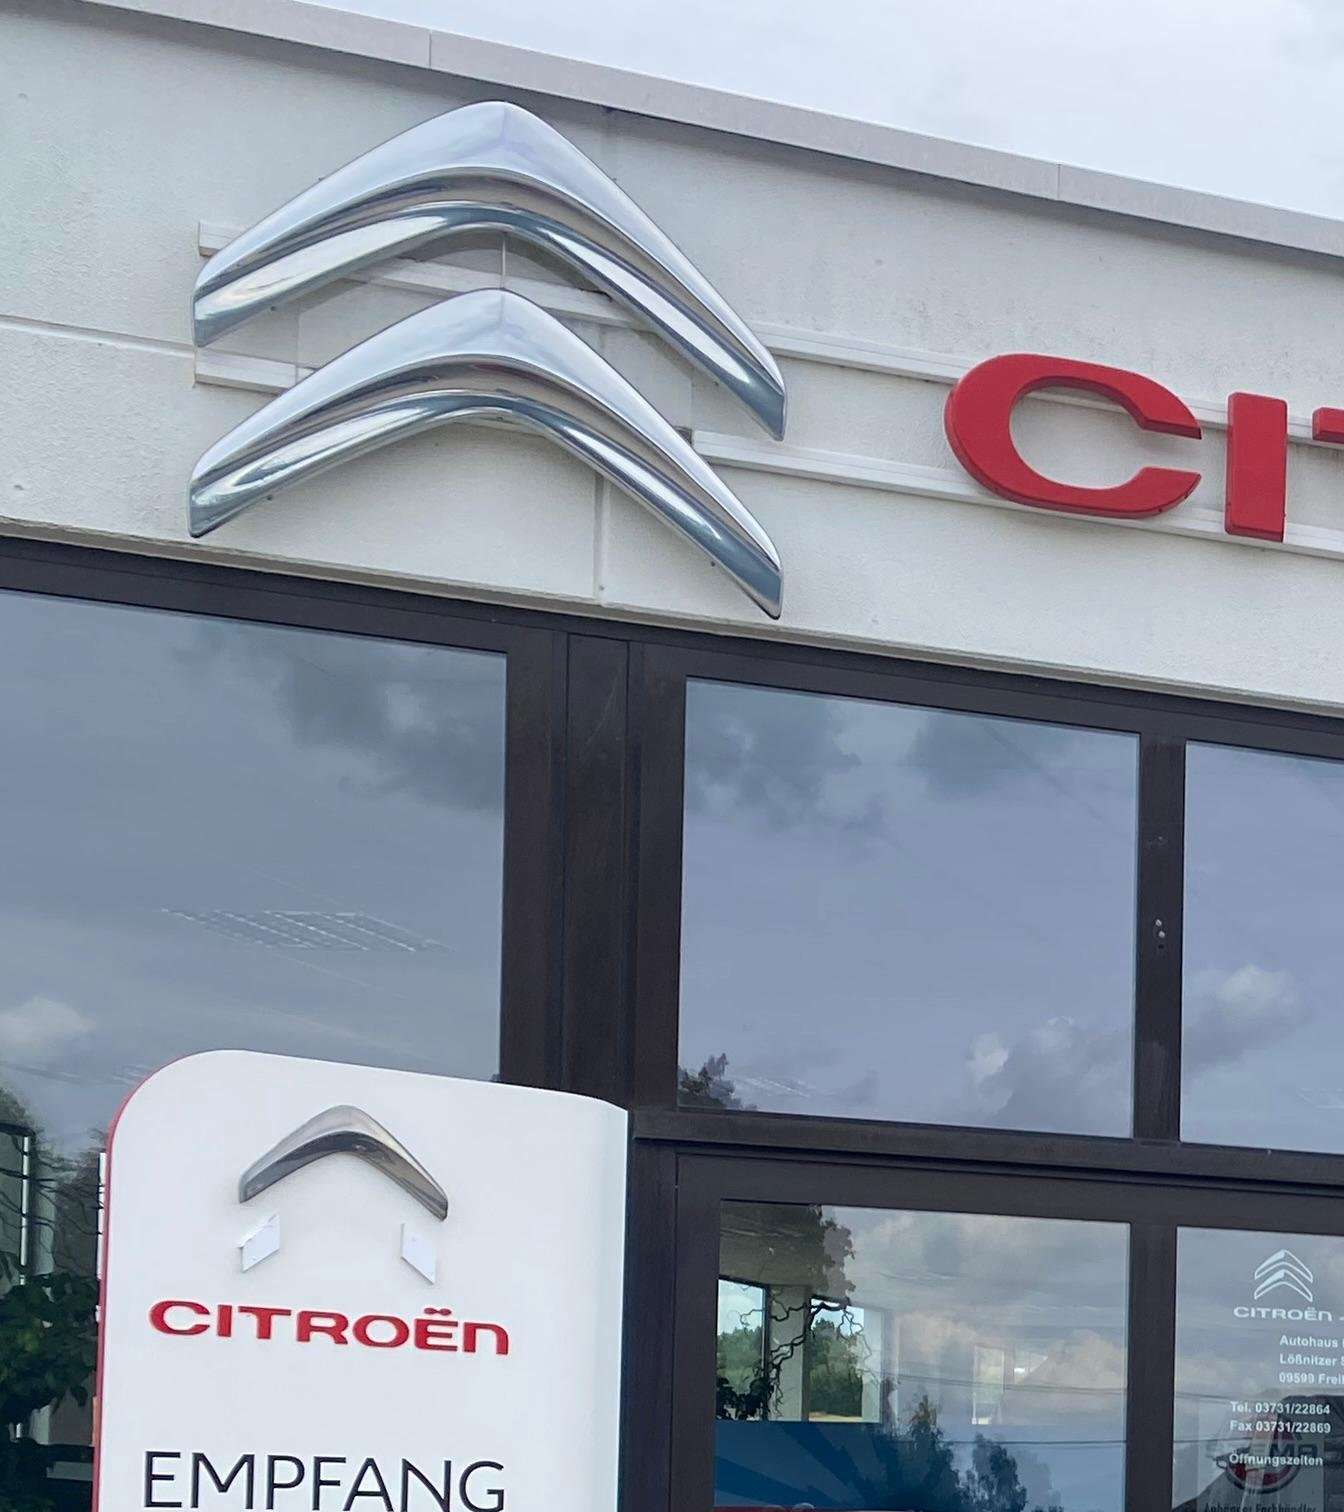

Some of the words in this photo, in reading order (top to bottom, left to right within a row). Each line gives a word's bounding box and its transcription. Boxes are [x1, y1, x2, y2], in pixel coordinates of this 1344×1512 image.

[1233, 1306, 1332, 1322] CITROËN
[148, 1299, 510, 1356] CITROËN
[1279, 1335, 1338, 1349] Autohaus
[1230, 1402, 1251, 1414] Tel.
[1255, 1403, 1330, 1415] 03731/22864
[1229, 1420, 1252, 1432] Fax
[1255, 1421, 1331, 1434] 03731/22869
[1229, 1450, 1324, 1467] Öffnungszeiten
